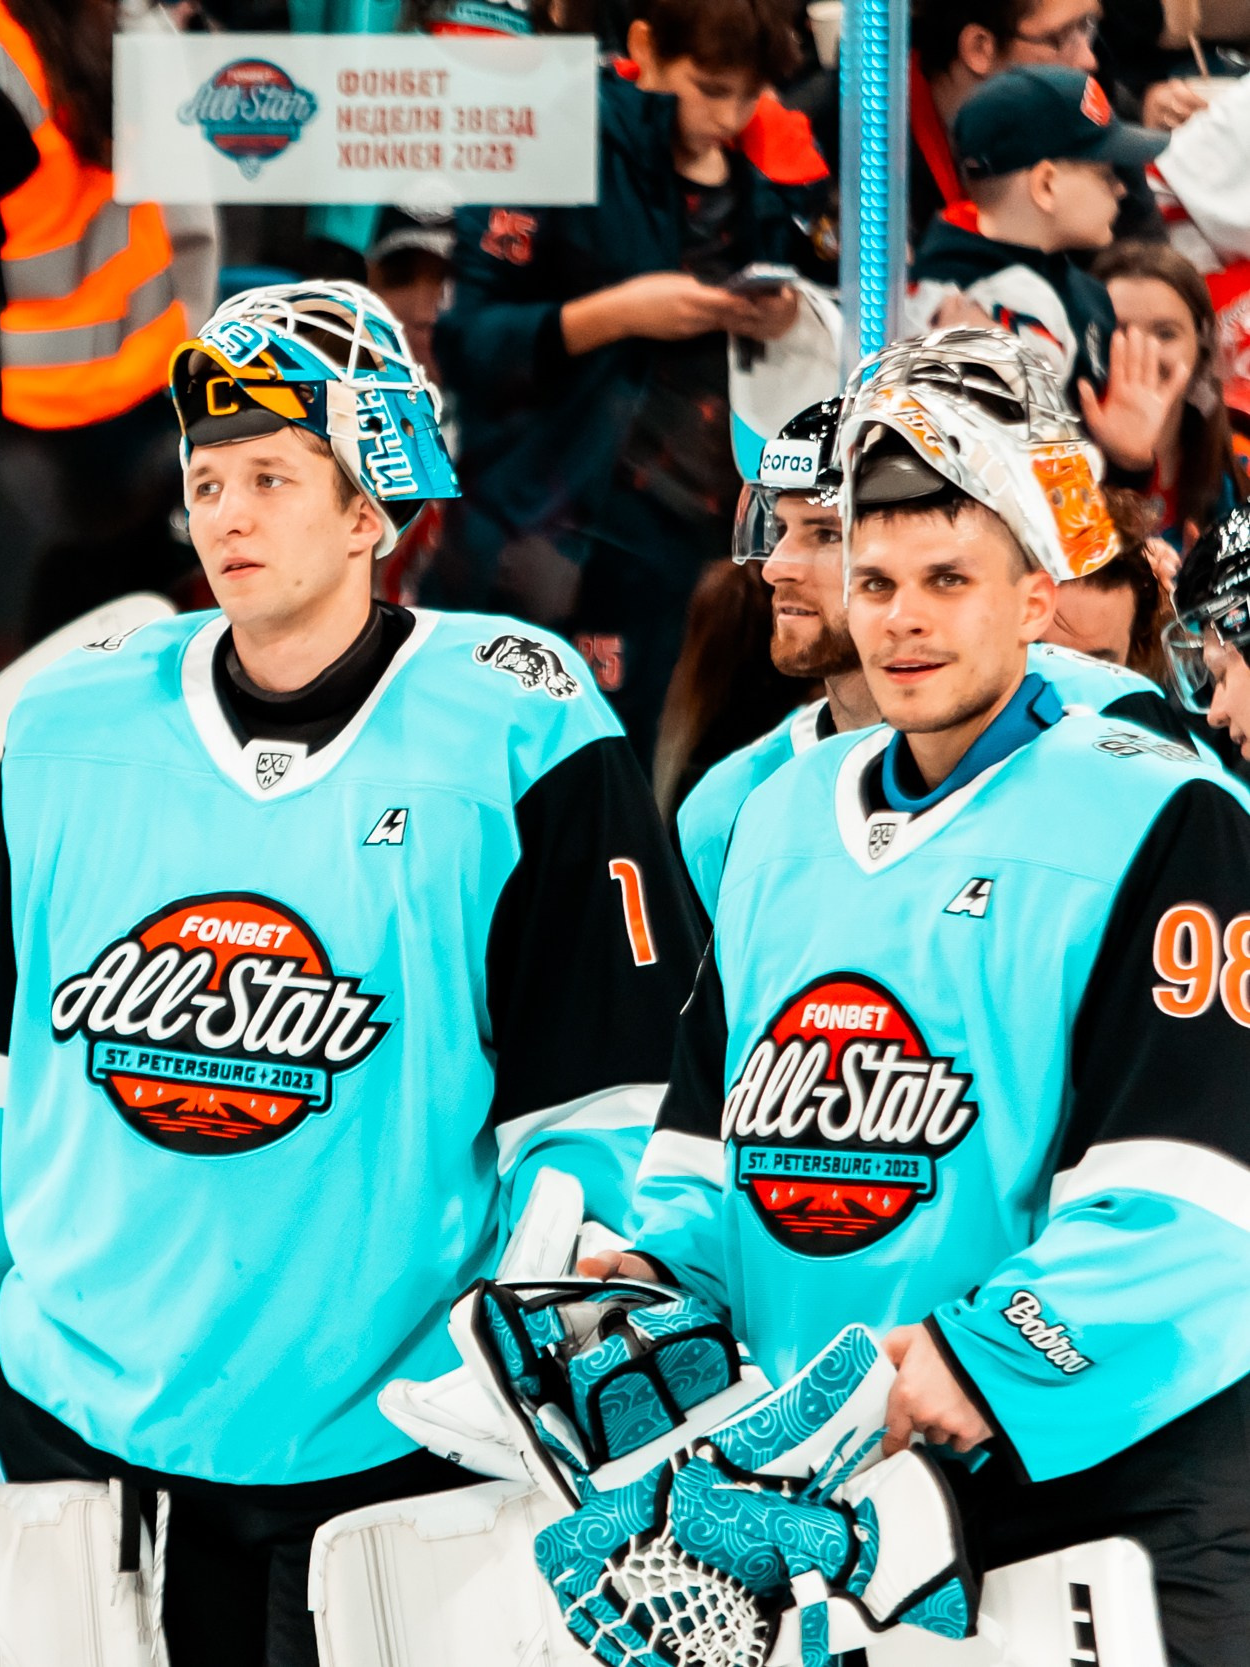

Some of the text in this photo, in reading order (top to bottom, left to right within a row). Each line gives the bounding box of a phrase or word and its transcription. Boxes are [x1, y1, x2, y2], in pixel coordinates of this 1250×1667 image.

[337, 69, 448, 97] ФОНБЕТ
[336, 106, 536, 137] НЕДЕЛЯ ЗВЕЗД
[337, 142, 515, 171] ХОККЕЯ 2023
[609, 859, 659, 967] 1
[180, 915, 291, 949] FONBET
[52, 941, 376, 1062] All-Star
[800, 1003, 889, 1031] FONBET
[104, 1048, 314, 1090] ST. PETERSBURG 2023
[721, 1040, 972, 1145] All-Star
[748, 1152, 920, 1178] ST. PETERSBURG 2023
